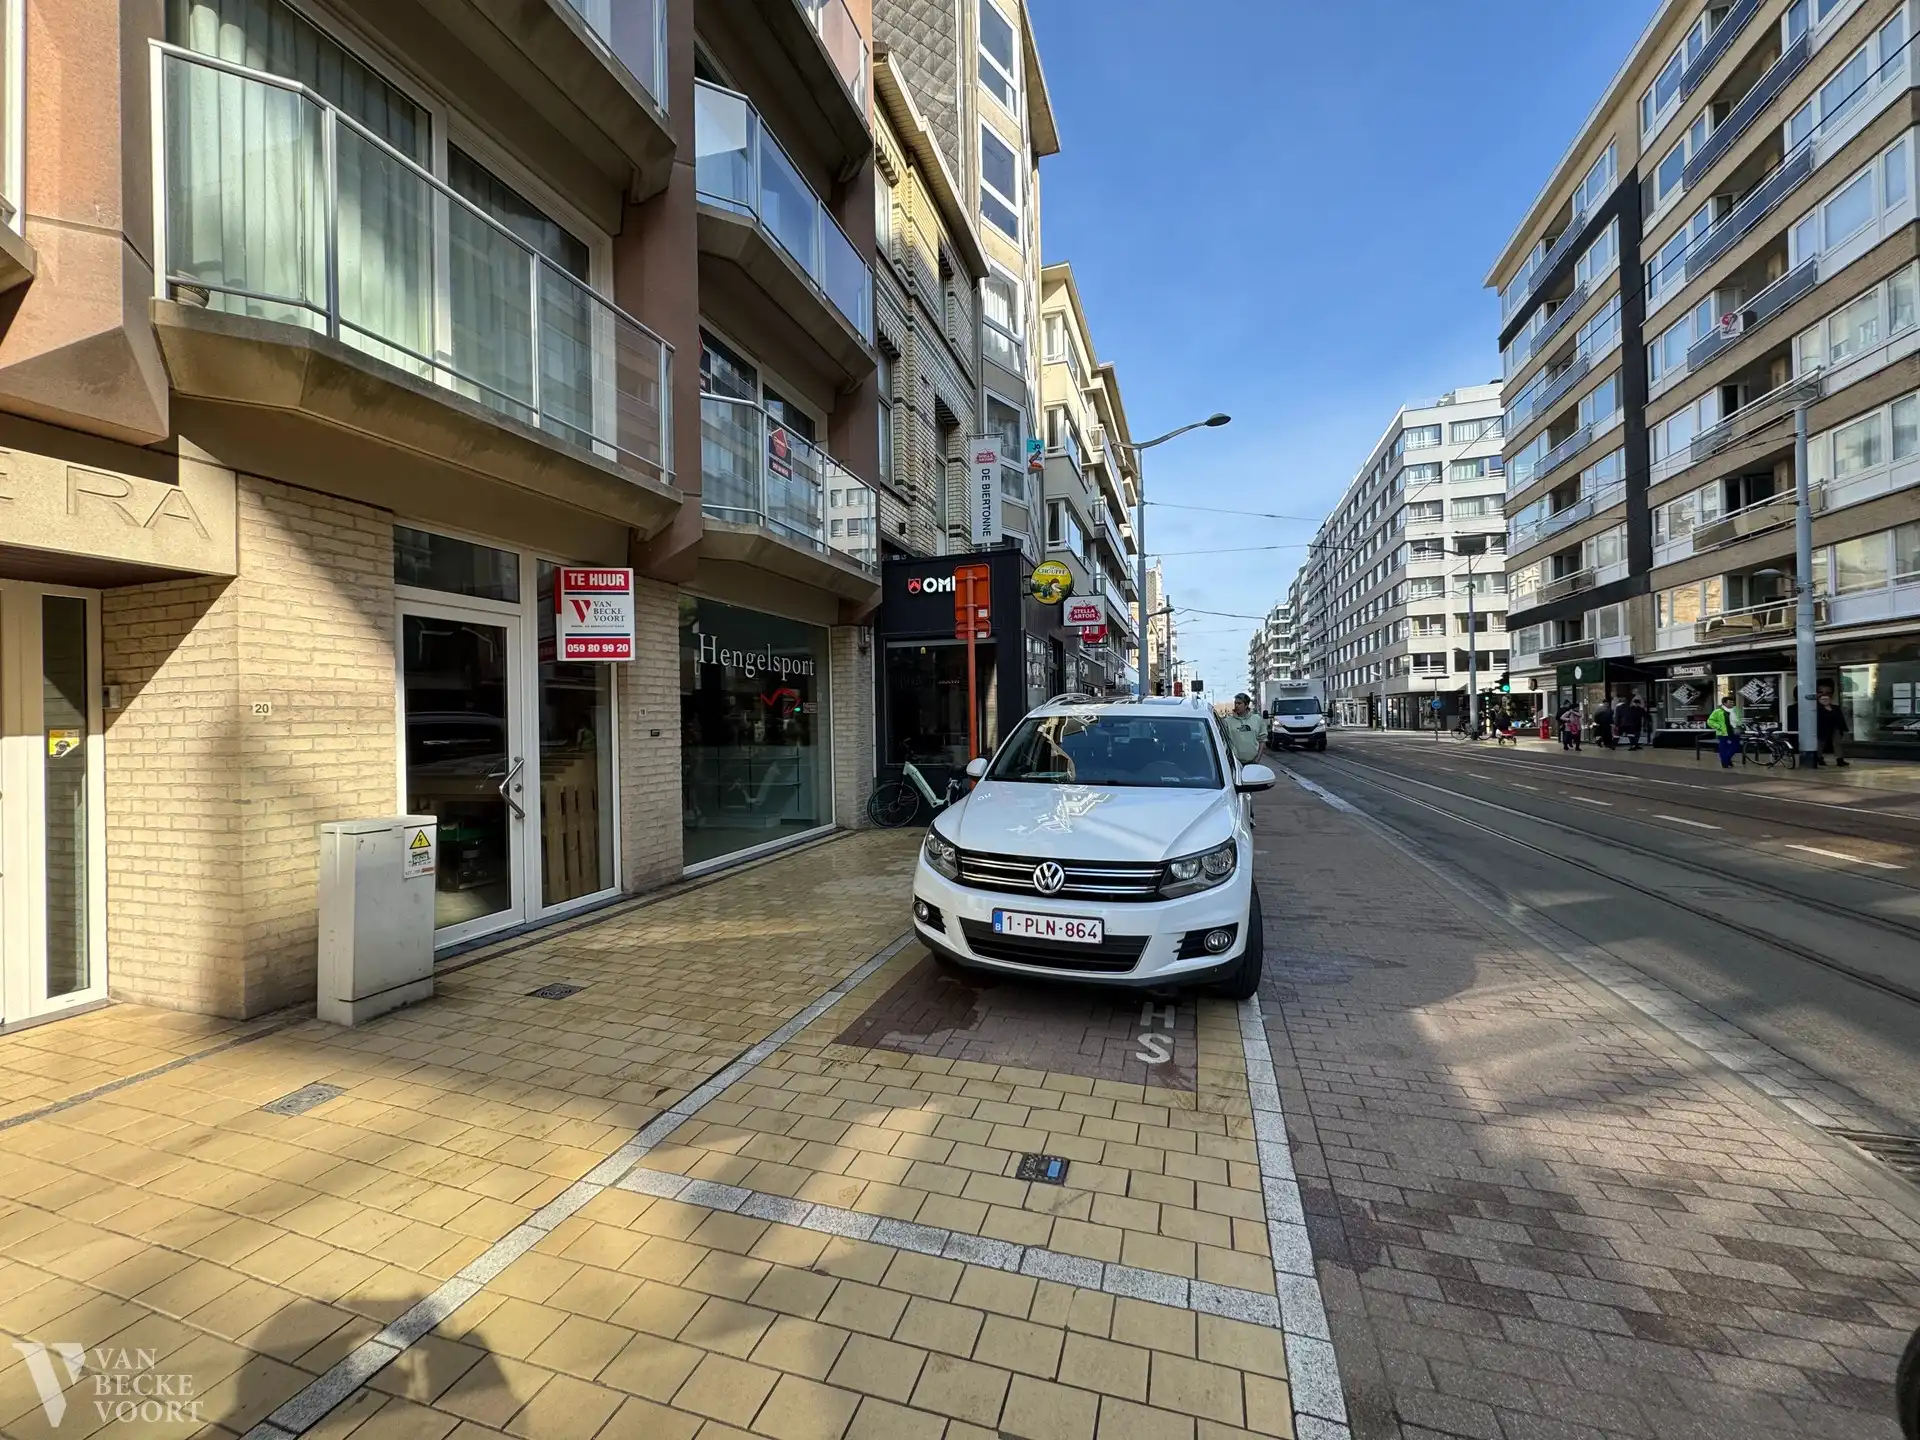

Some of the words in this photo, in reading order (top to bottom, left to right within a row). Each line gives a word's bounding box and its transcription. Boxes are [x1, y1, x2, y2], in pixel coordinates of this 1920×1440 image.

[982, 468, 990, 481] DE
[982, 484, 991, 537] BIERTONNE
[569, 573, 585, 586] TE
[589, 573, 625, 586] HUUR
[567, 643, 585, 653] 059
[588, 643, 600, 652] 80
[602, 643, 615, 652] 99
[617, 643, 629, 652] 20
[699, 633, 815, 681] Hengelsport
[255, 704, 269, 713] 20
[1007, 916, 1097, 939] 1-PLN-864
